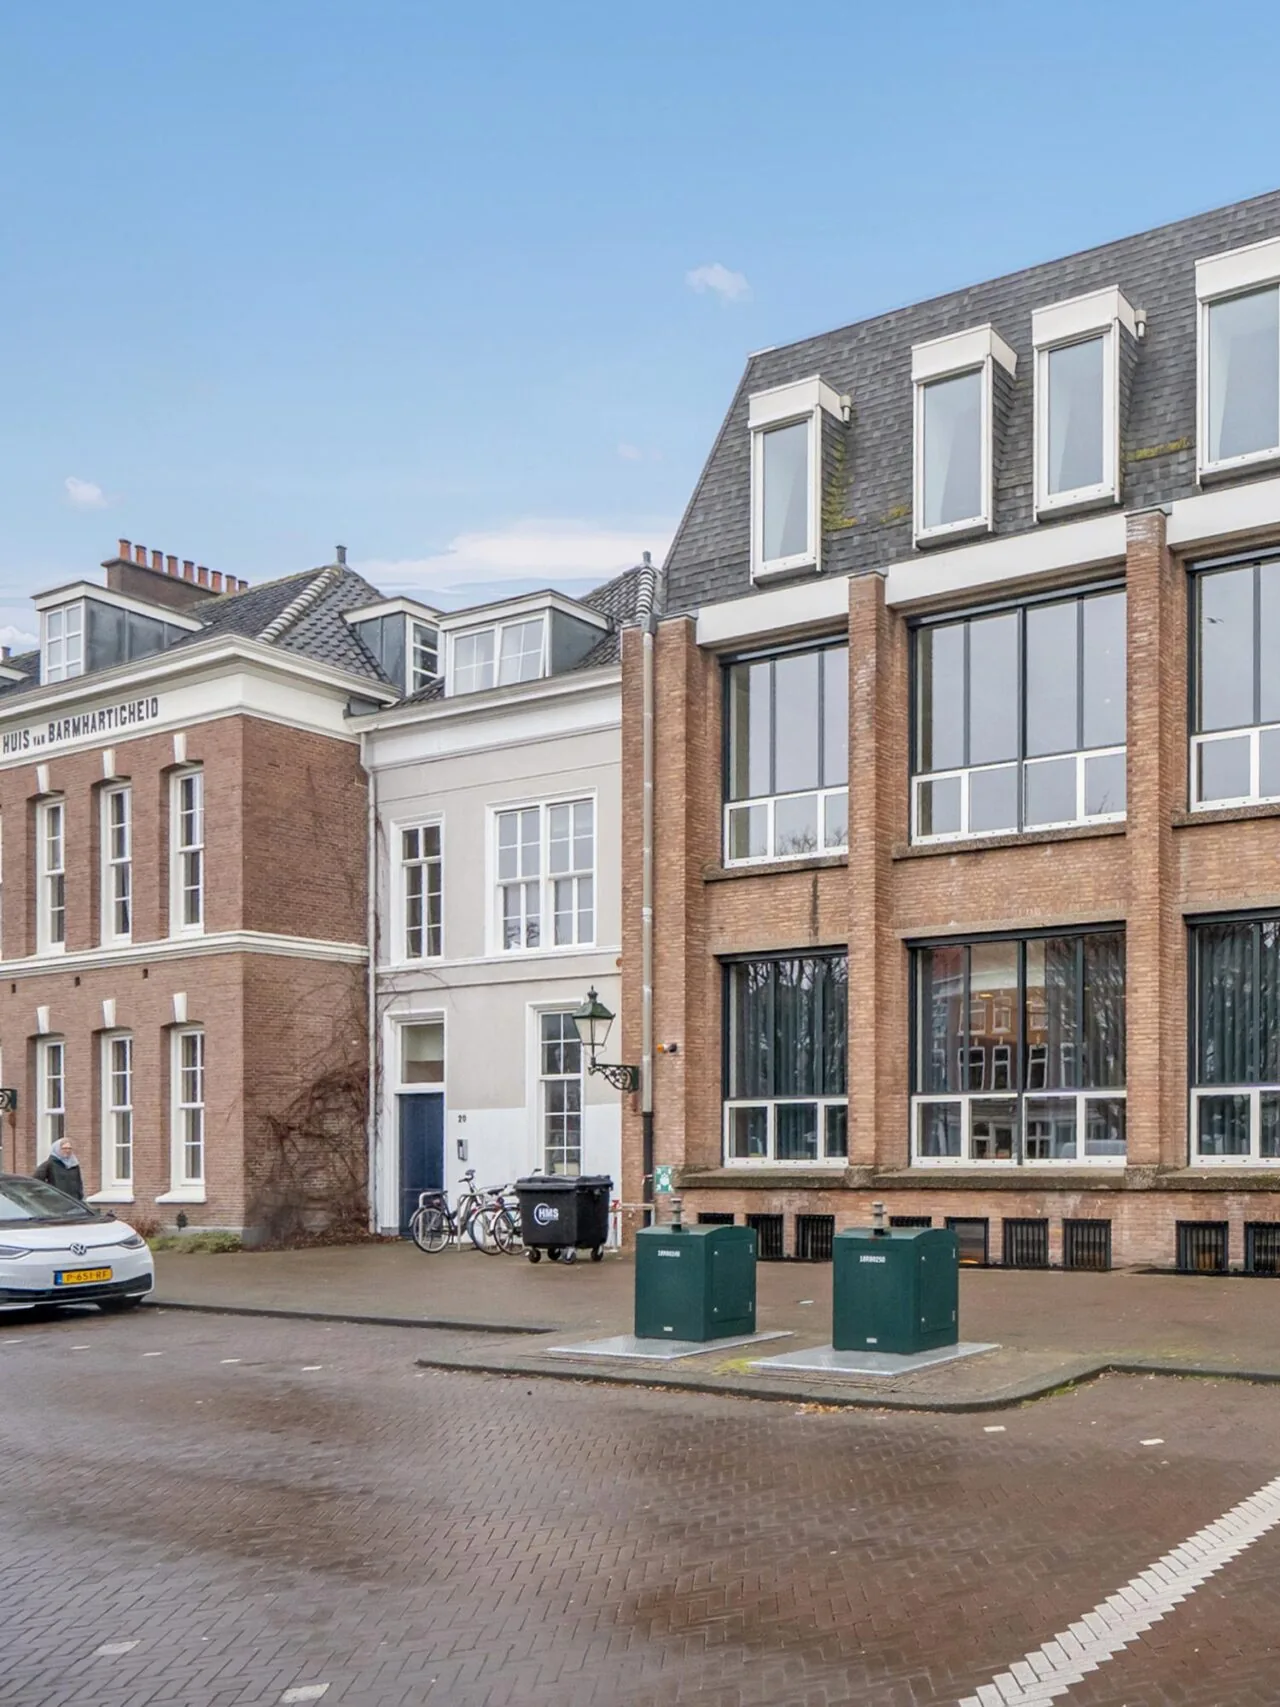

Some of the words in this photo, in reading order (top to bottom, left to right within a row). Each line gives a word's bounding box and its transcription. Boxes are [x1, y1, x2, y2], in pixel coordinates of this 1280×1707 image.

[2, 729, 30, 754] HUIS
[33, 734, 45, 747] VAN
[48, 696, 159, 743] BARMHARTIGHEID
[457, 1114, 467, 1123] 20
[538, 1207, 559, 1218] HMS
